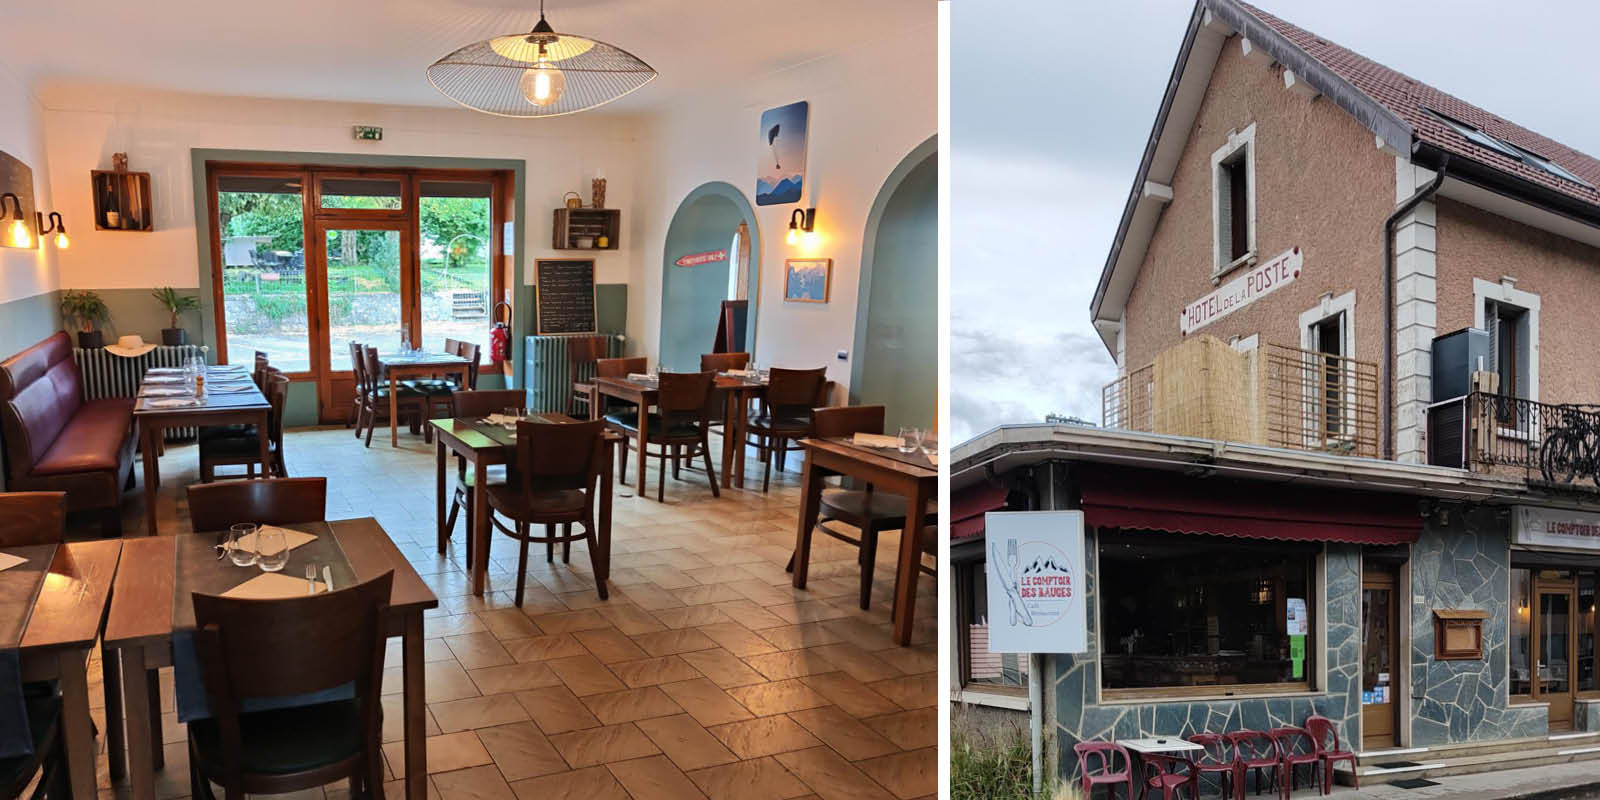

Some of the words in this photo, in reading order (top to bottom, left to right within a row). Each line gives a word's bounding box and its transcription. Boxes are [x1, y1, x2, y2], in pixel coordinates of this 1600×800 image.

[1188, 295, 1222, 328] HOTEL
[1223, 296, 1234, 310] DE
[1235, 289, 1247, 304] LA
[1247, 256, 1290, 297] POSTE
[1546, 520, 1556, 534] LE
[1020, 576, 1031, 586] LE
[1032, 575, 1072, 586] COMPTOIR
[1021, 587, 1037, 598] DES
[1038, 587, 1072, 598] BAUGES
